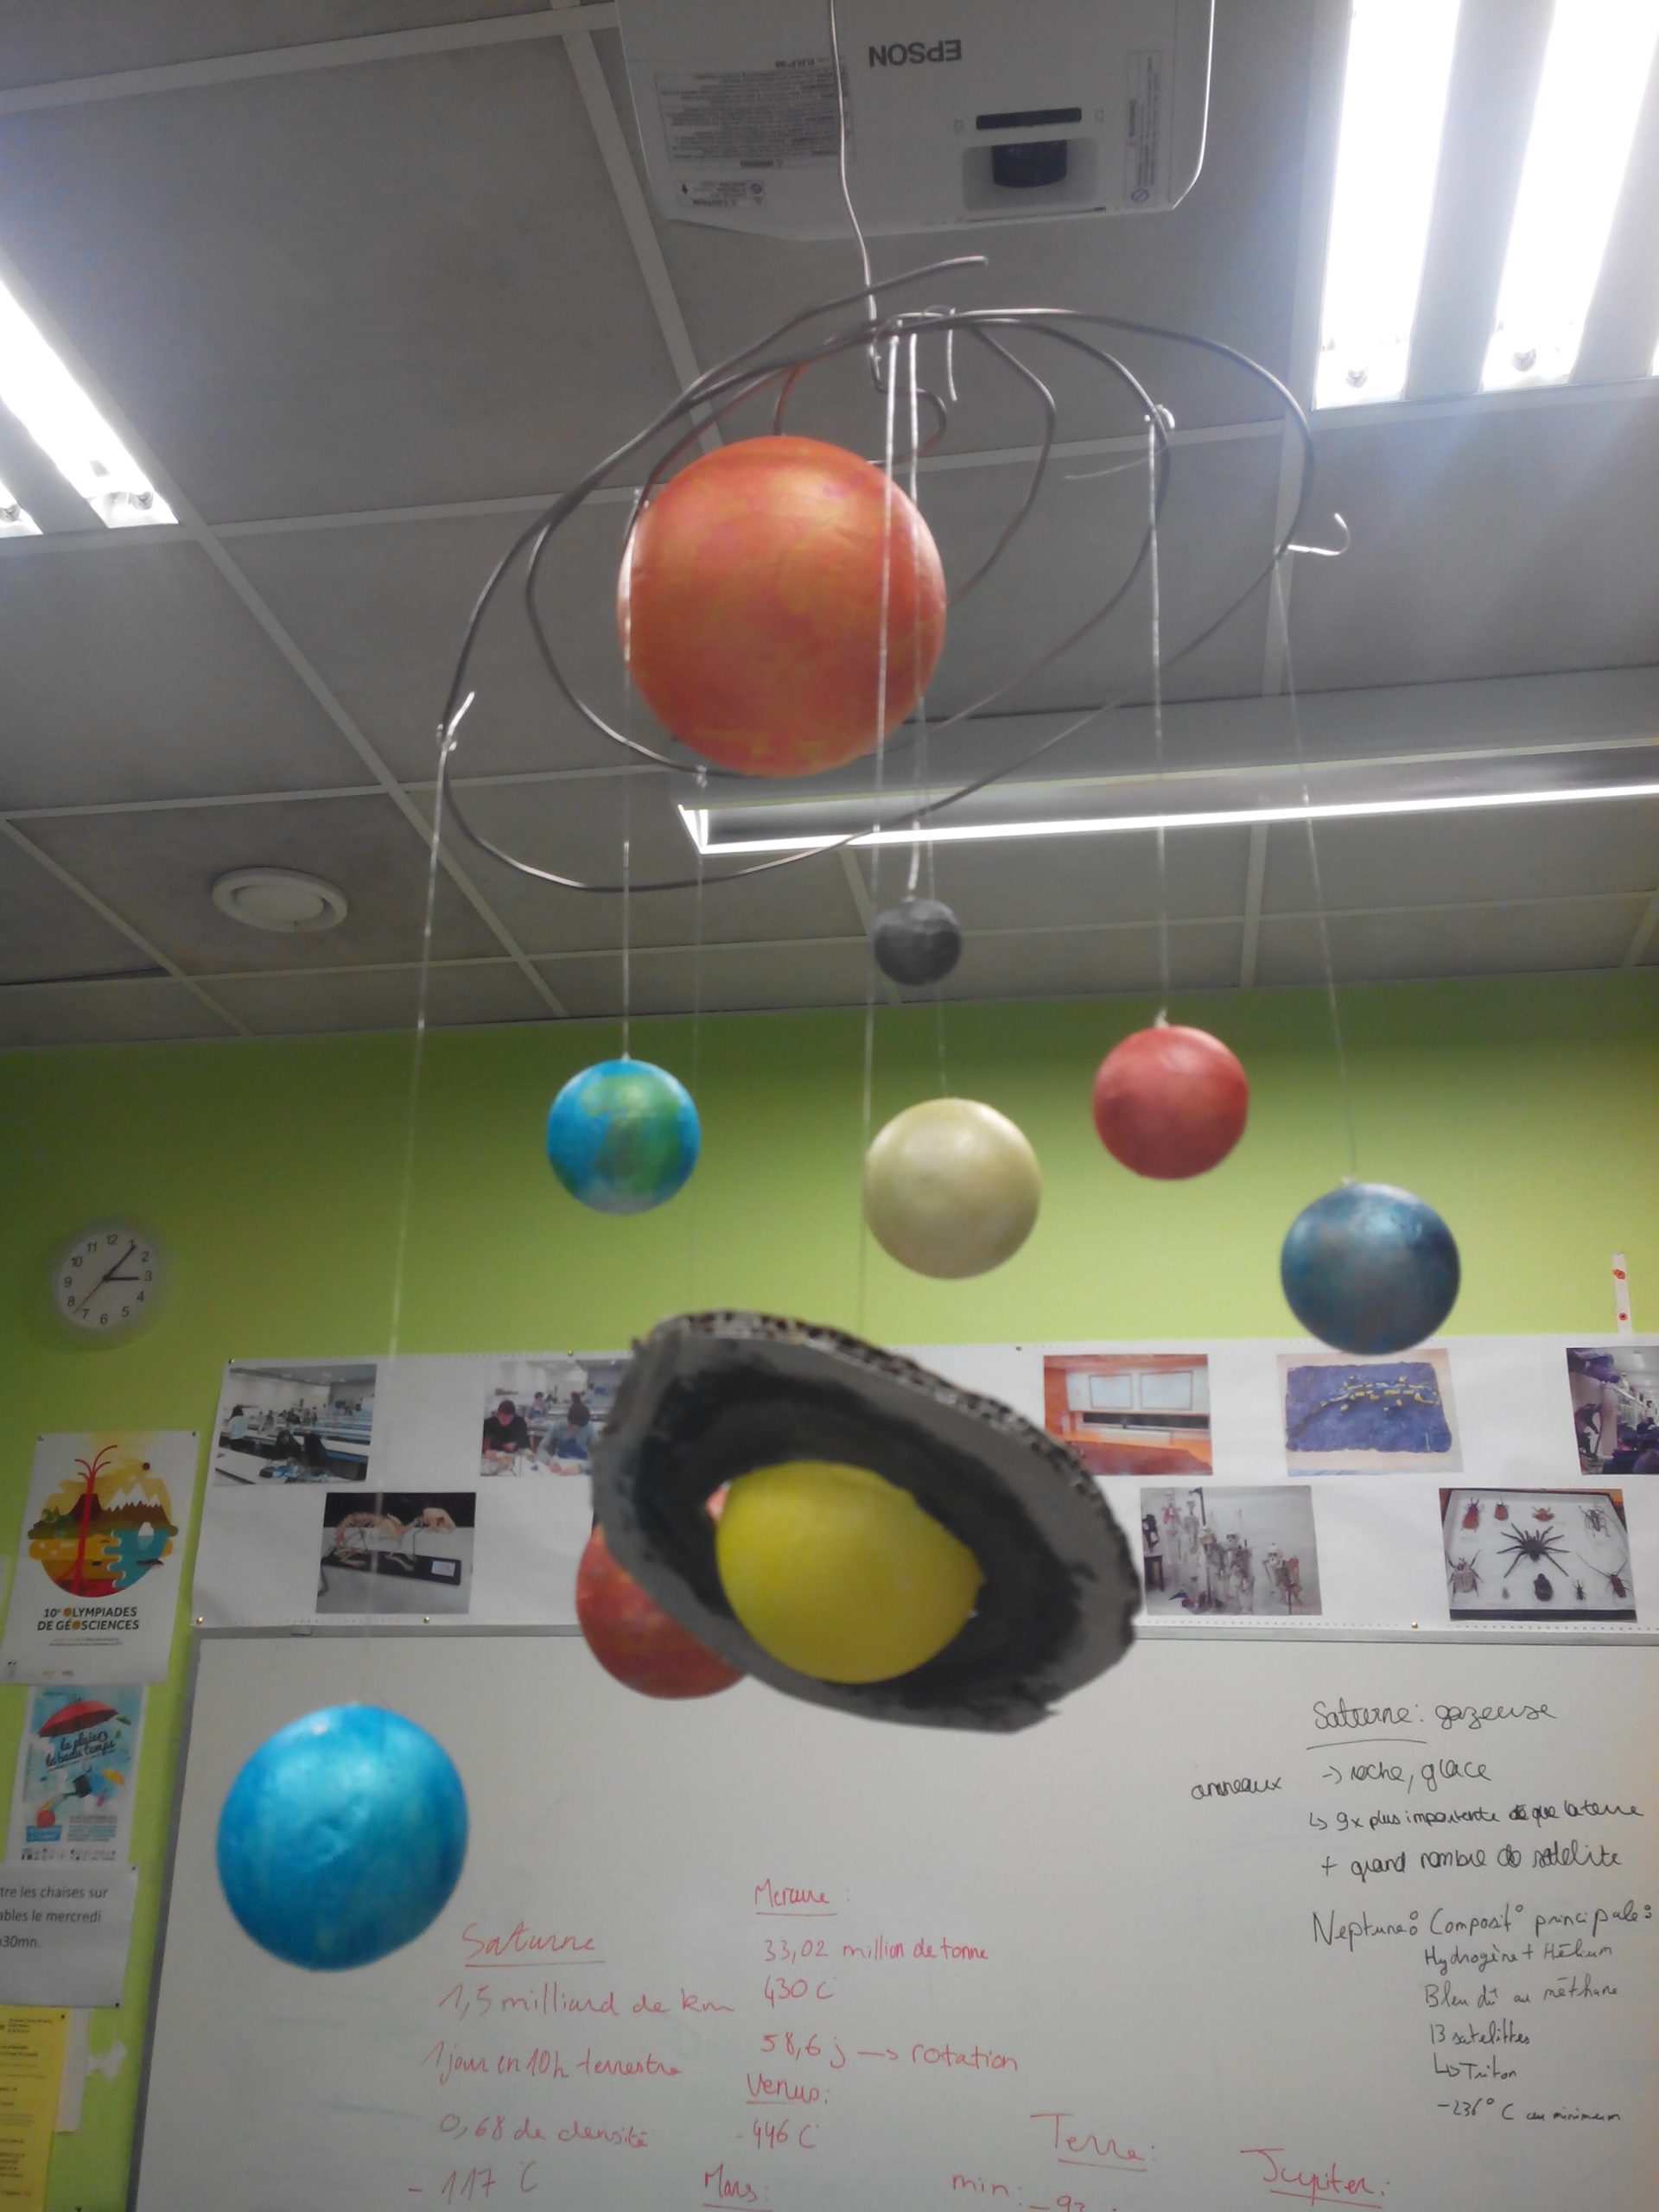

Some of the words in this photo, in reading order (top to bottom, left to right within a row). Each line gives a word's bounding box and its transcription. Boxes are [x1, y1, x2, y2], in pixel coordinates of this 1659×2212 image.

[868, 39, 963, 69] EPSON
[105, 1233, 118, 1246] 12
[86, 1242, 98, 1252] 11
[71, 1256, 83, 1268] 10
[142, 1250, 149, 1262] 2
[144, 1269, 152, 1281] 3
[64, 1276, 73, 1288] 9
[67, 1295, 75, 1306] 8
[137, 1290, 144, 1301] 4
[82, 1308, 90, 1319] 7
[122, 1306, 130, 1317] 5
[100, 1313, 108, 1325] 6
[62, 1606, 137, 1618] OLYMPIADES
[37, 1620, 54, 1631] DE
[55, 1618, 140, 1631] GÉOSCIENCES
[1370, 1809, 1402, 1830] plus
[20, 1885, 36, 1897] les
[40, 1885, 85, 1898] chaises
[88, 1887, 109, 1898] sur
[32, 1910, 42, 1922] le
[46, 1910, 103, 1923] mercredi
[461, 1920, 596, 1960] Saturne
[763, 1938, 829, 1964] 33,02
[842, 1934, 905, 1961] million
[913, 1937, 937, 1960] de
[939, 1936, 988, 1961] tonne
[1425, 1943, 1518, 1976] Hydrogène
[1544, 1938, 1612, 1961] Hélium
[764, 1975, 808, 2008] 430
[1425, 1980, 1469, 2008] Bleu
[1514, 1993, 1530, 2004] au
[438, 1982, 492, 2020] 1,5
[502, 1981, 620, 2016] milliard
[632, 1993, 670, 2013] de
[681, 1987, 735, 2013] km
[1430, 2023, 1446, 2044] 13
[760, 2031, 821, 2061] 58,6
[830, 2036, 846, 2069] j
[912, 2043, 1019, 2072] rotation
[525, 2047, 569, 2079] 10h
[1459, 2054, 1517, 2080] Triton
[1553, 2107, 1621, 2121] minimum
[439, 2113, 505, 2141] 0,68
[513, 2117, 546, 2141] de
